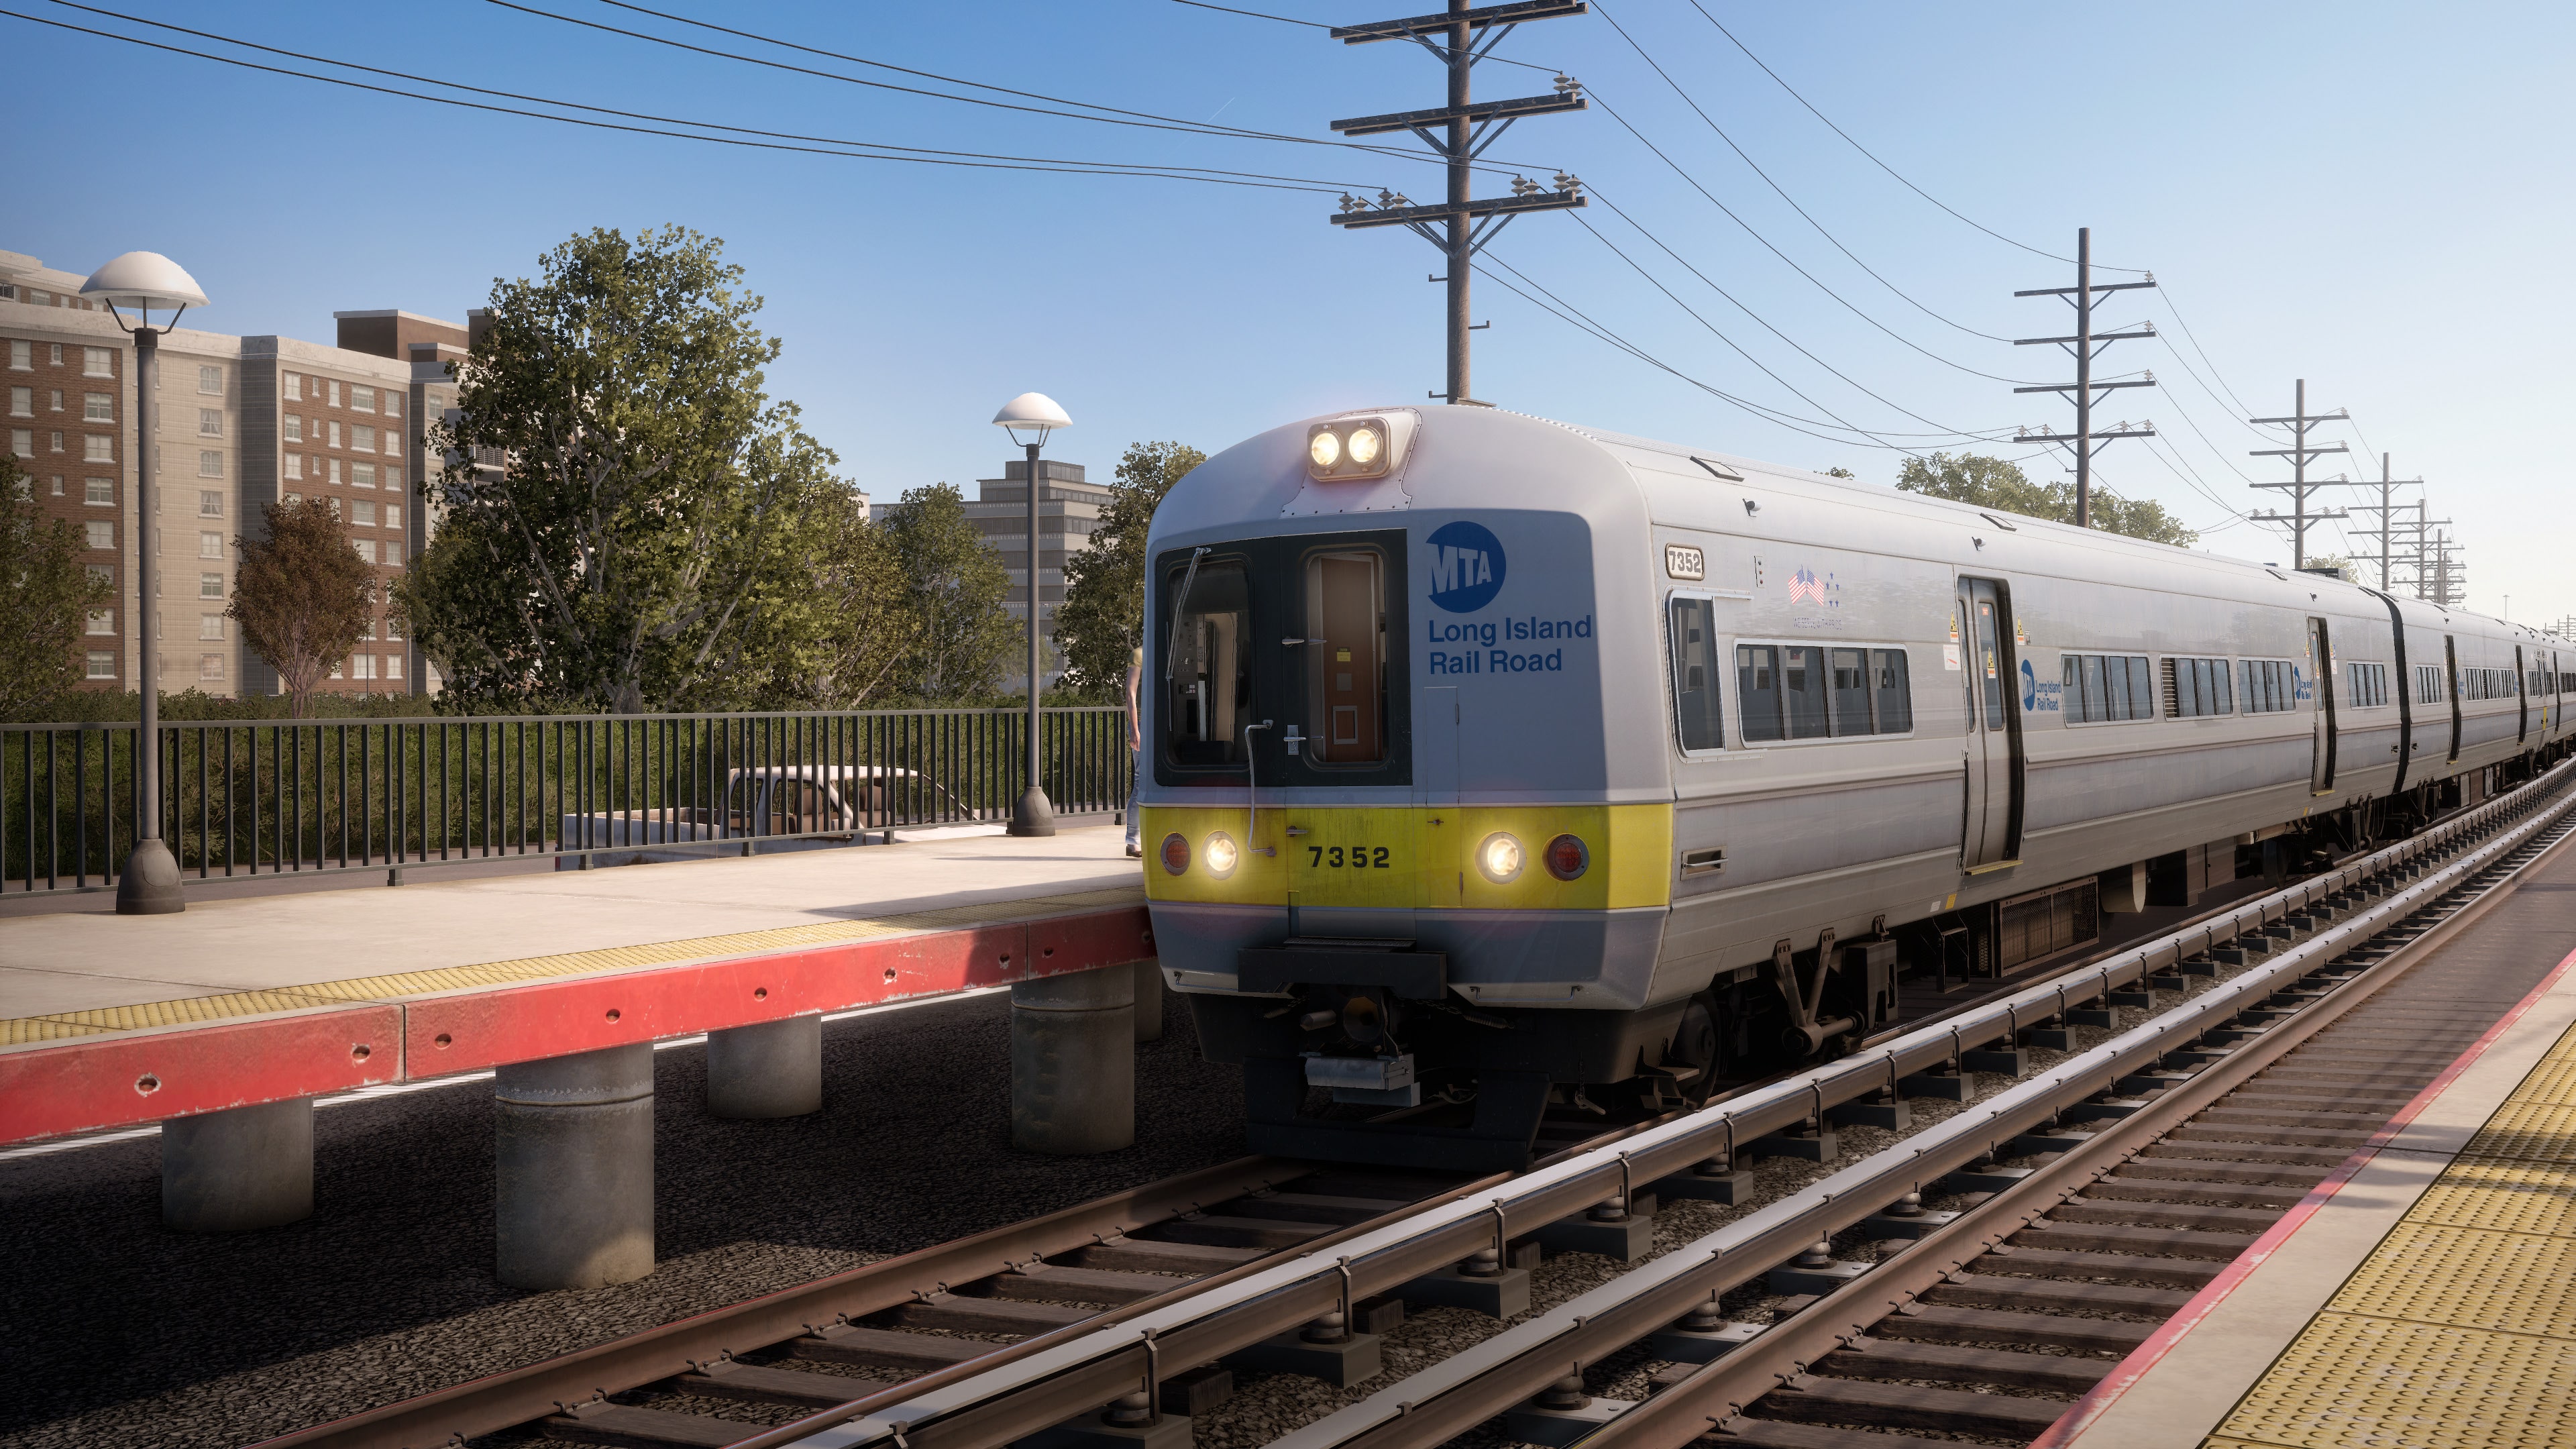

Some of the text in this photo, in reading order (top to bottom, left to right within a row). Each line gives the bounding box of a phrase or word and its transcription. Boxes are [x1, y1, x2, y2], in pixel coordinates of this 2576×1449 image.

[1427, 542, 1493, 596] MTA
[1668, 550, 1701, 574] 7352
[1429, 614, 1591, 647] Long Island
[1430, 648, 1562, 675] Rail Road
[2035, 680, 2061, 696] Long Island
[2037, 697, 2059, 711] Rail Road
[1308, 846, 1390, 868] 7352
